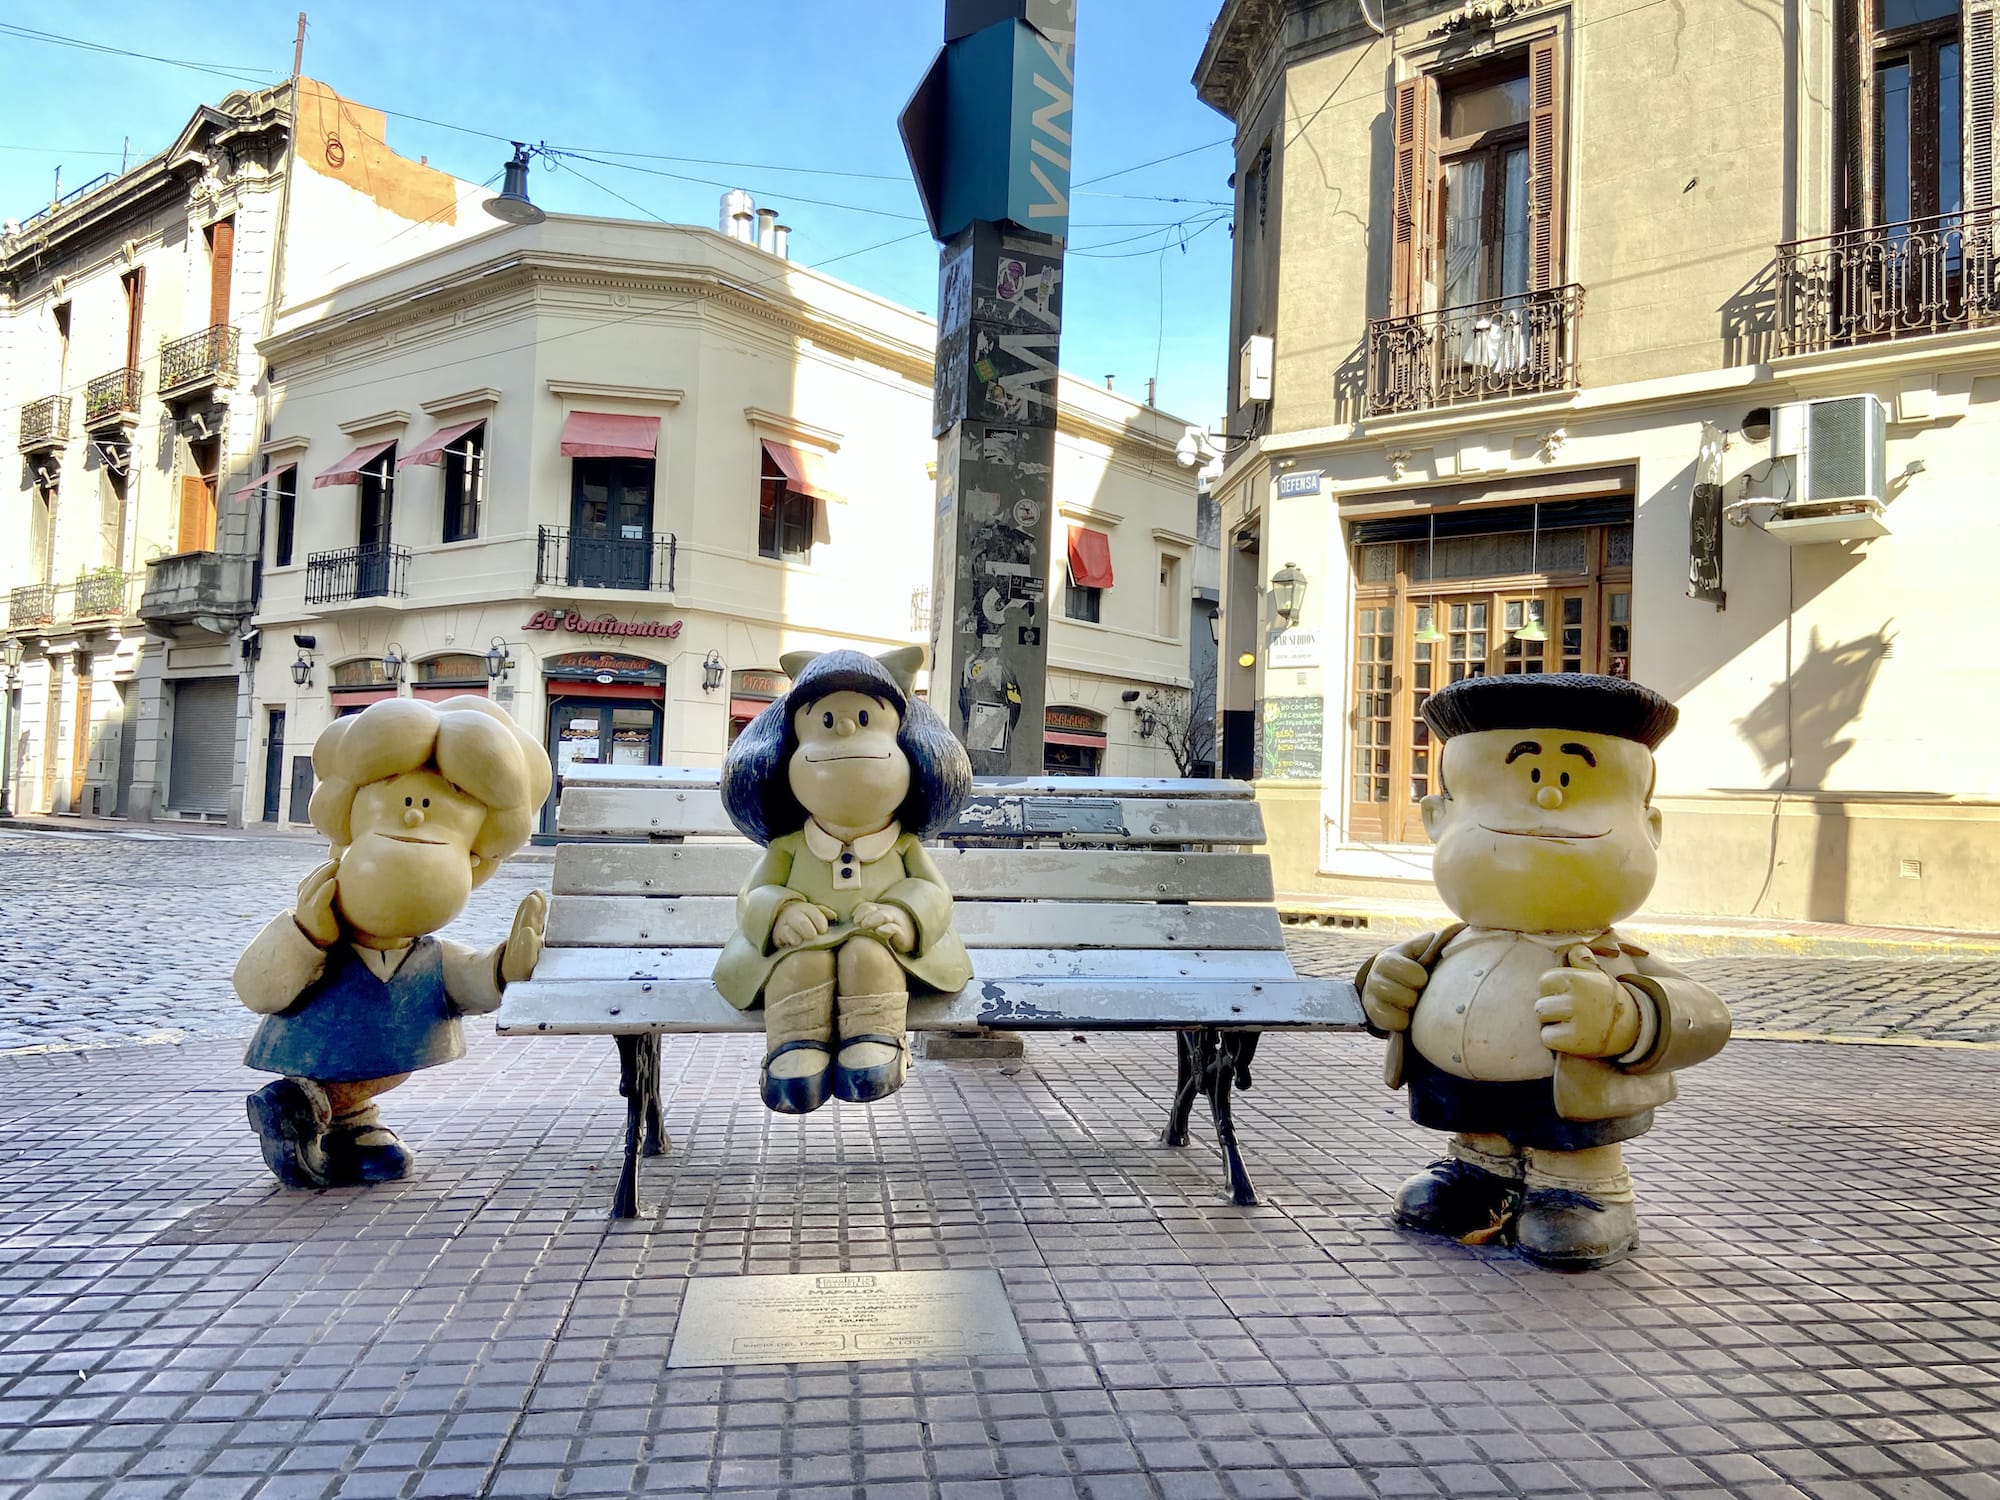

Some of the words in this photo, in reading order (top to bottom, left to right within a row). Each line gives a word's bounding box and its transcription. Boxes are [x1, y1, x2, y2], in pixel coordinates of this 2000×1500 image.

[1281, 476, 1318, 493] DEFENSA
[521, 611, 557, 631] La
[564, 611, 684, 639] Continental
